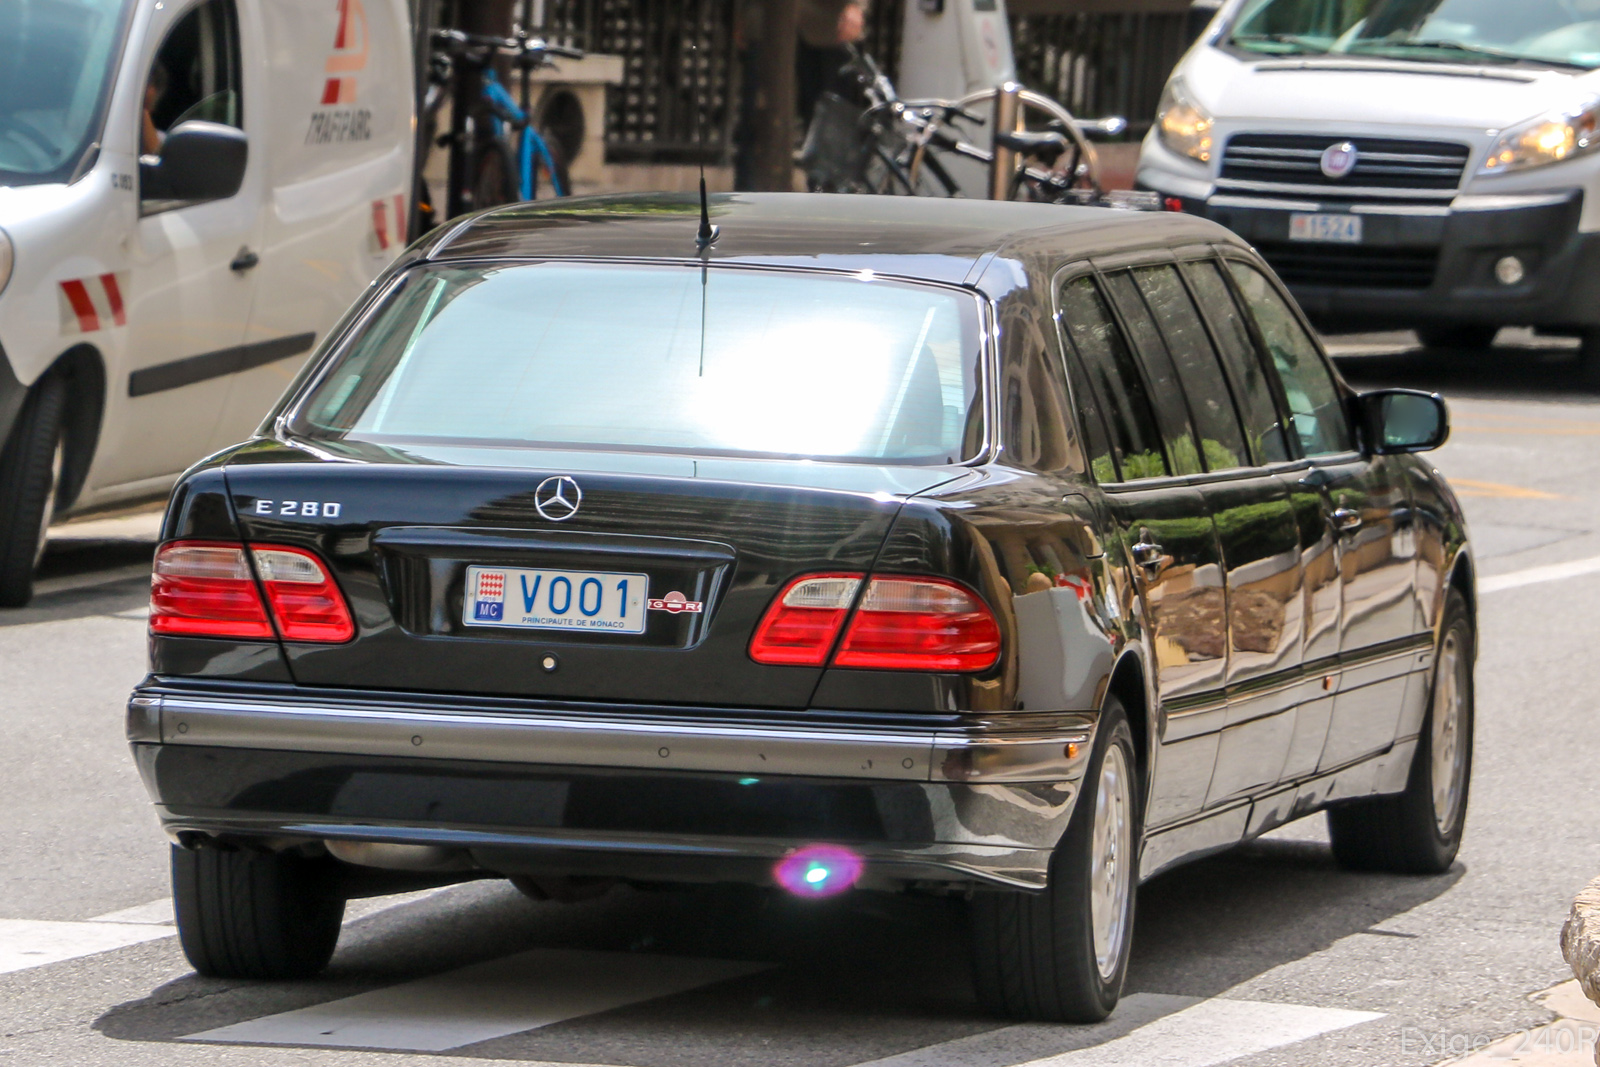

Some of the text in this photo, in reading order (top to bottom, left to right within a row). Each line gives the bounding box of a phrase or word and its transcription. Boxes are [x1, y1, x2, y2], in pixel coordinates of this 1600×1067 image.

[1310, 216, 1355, 237] 1524
[256, 500, 341, 518] E 280
[480, 603, 498, 617] MC
[521, 616, 573, 626] PRINCIPAUTE
[590, 620, 625, 629] MONACO
